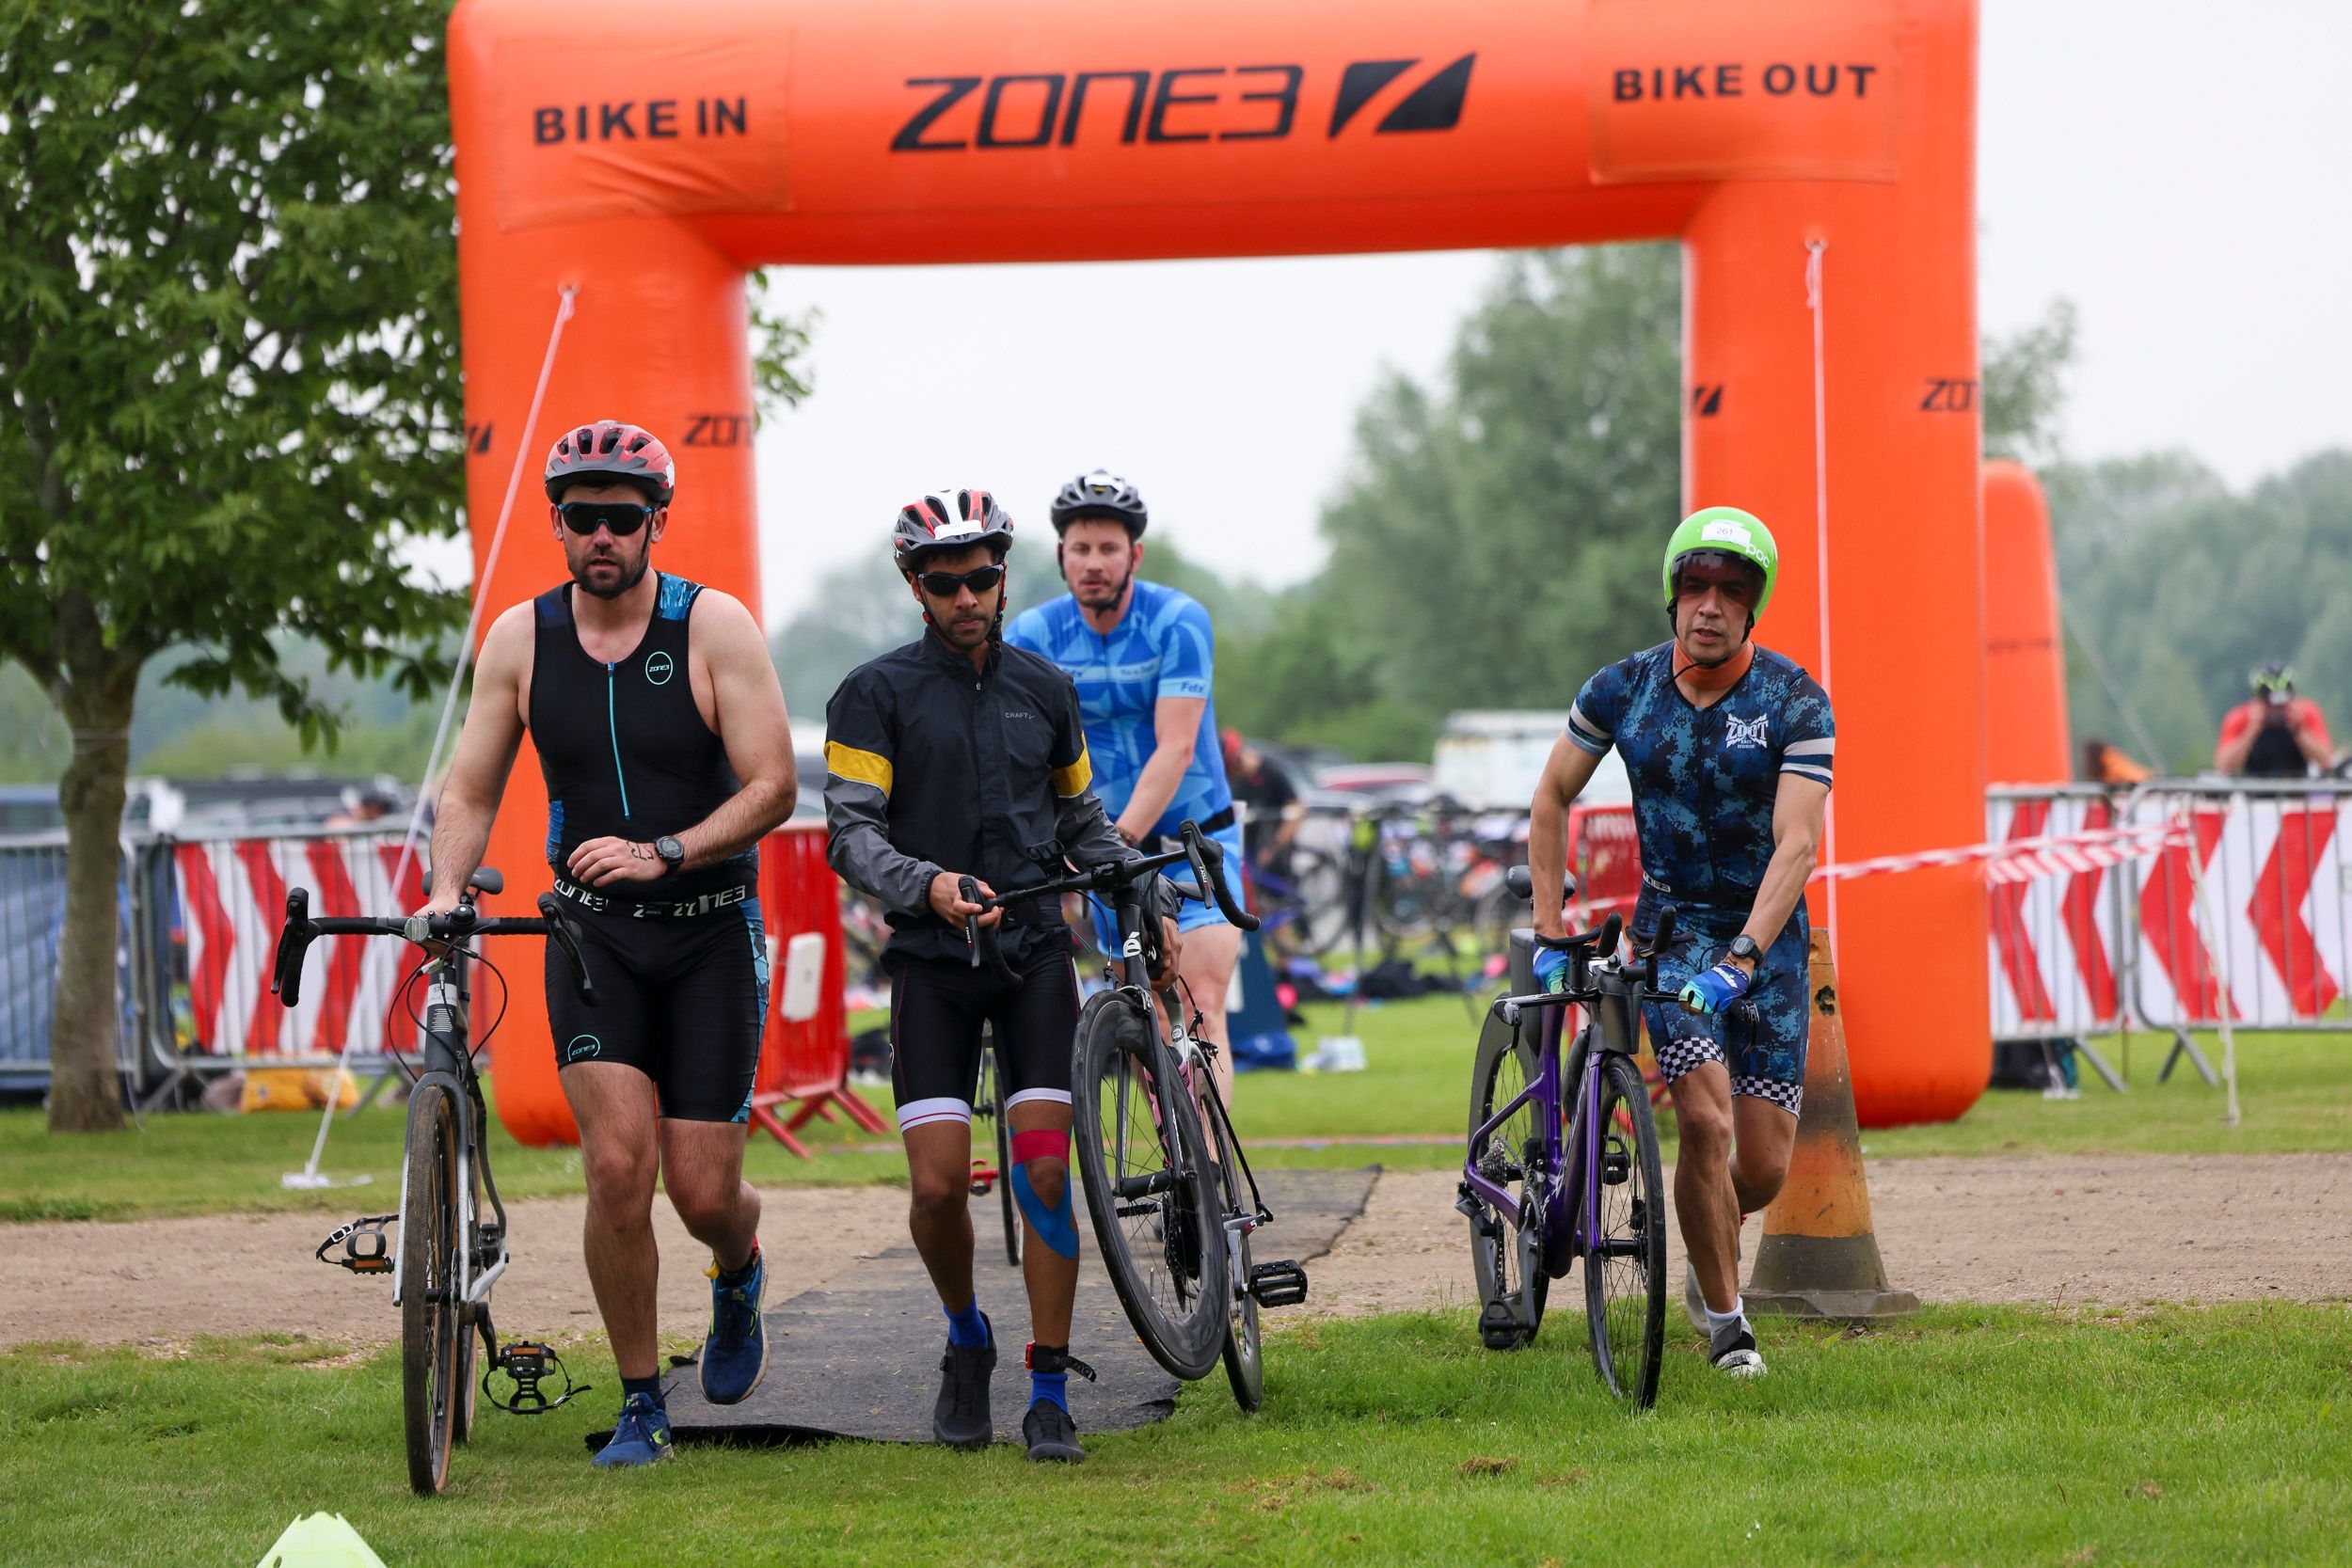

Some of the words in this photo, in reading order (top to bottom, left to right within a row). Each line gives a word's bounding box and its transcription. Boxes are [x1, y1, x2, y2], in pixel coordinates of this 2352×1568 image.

[1613, 64, 1744, 103] BIKE
[1762, 63, 1877, 98] OUT
[533, 100, 678, 147] BIKE
[698, 97, 747, 136] IN
[890, 63, 1304, 151] ZONE3
[648, 664, 670, 673] ZONE3
